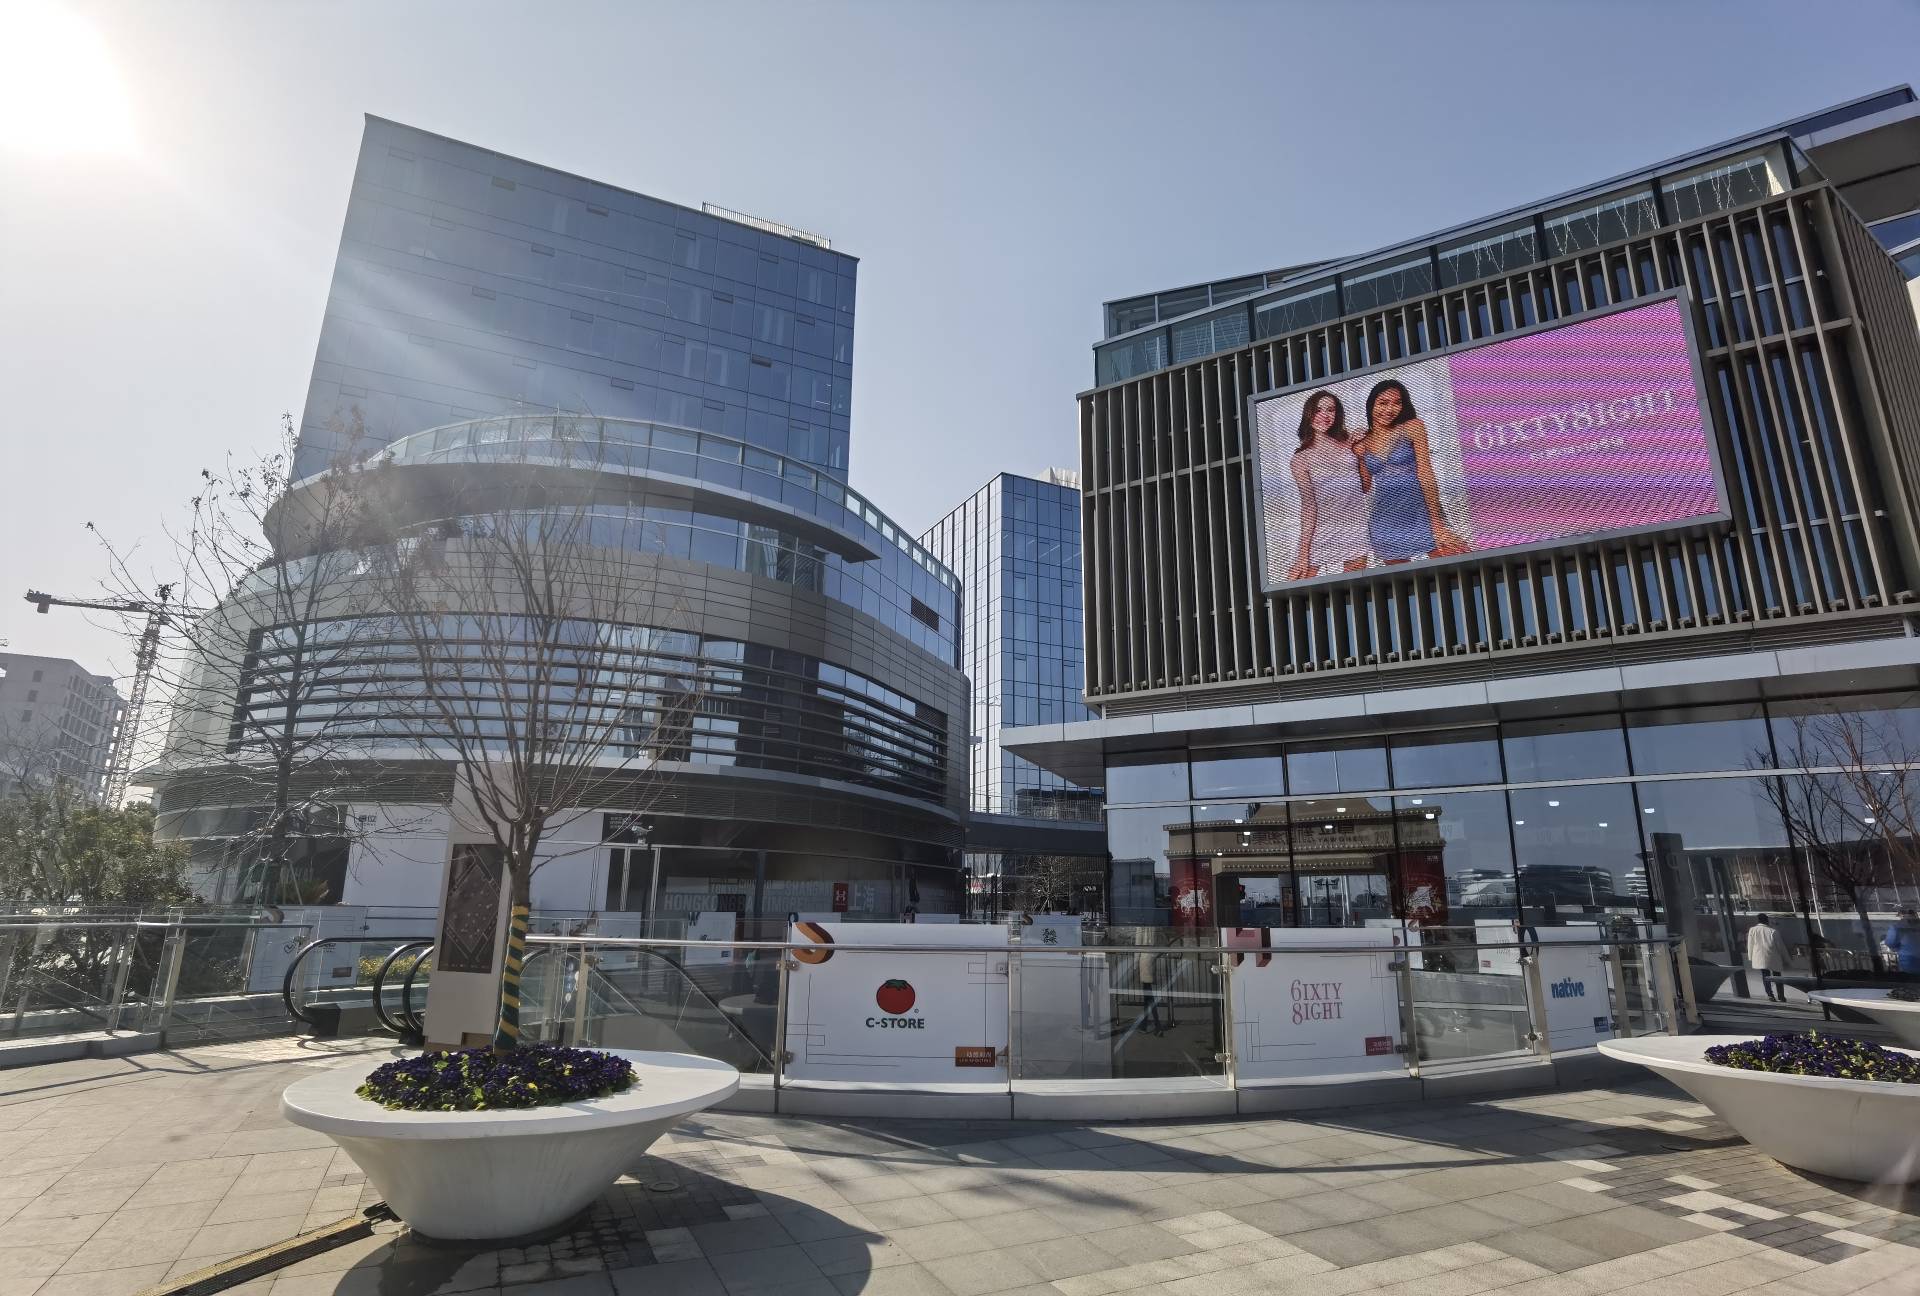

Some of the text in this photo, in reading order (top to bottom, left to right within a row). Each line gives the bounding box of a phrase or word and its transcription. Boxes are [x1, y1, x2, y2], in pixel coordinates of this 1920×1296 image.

[1474, 389, 1679, 451] 6IXTY8IGHT
[1290, 979, 1342, 1001] 6IXTY
[1551, 977, 1585, 999] native
[865, 1017, 925, 1029] C-STORE
[1292, 1000, 1344, 1025] 8IGHT
